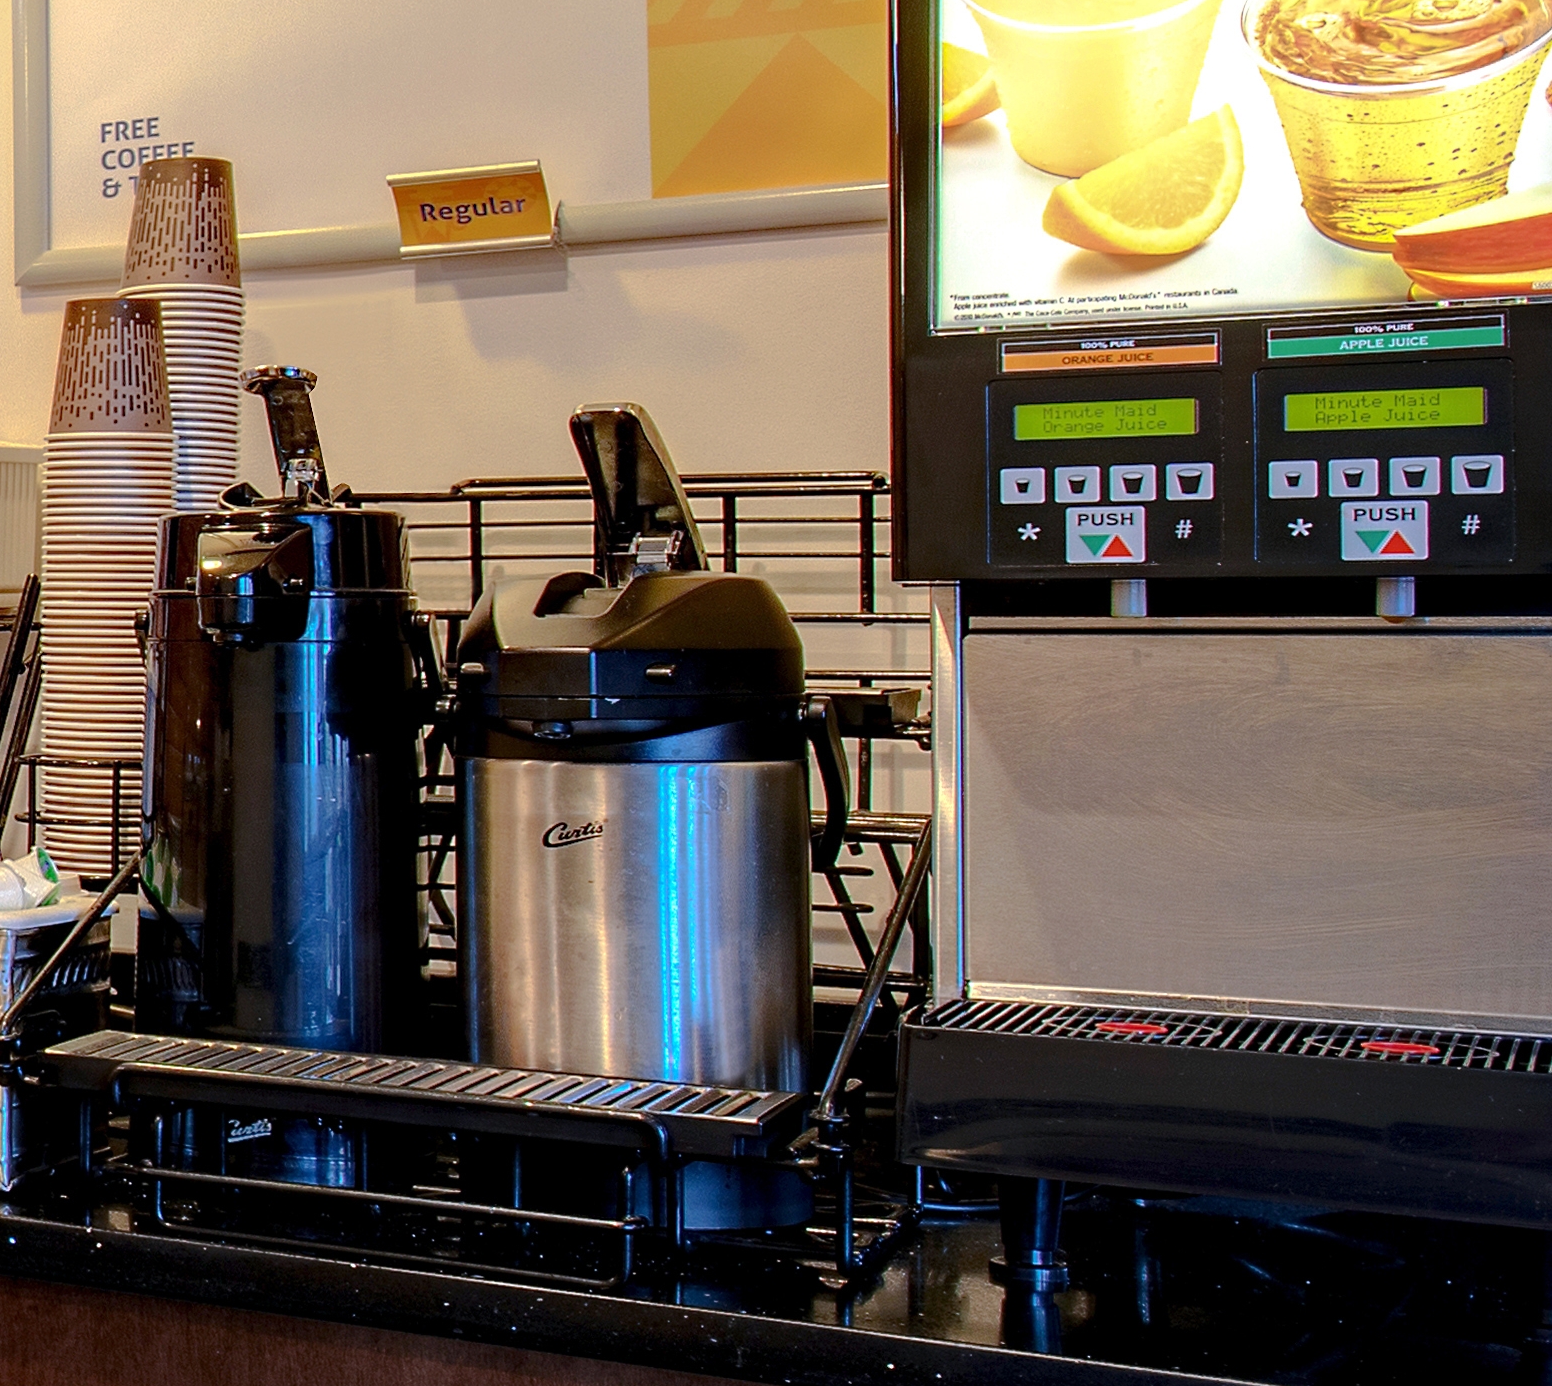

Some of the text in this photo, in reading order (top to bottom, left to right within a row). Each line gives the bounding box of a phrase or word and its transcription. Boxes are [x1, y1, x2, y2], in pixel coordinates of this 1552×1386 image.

[101, 117, 160, 143] FREE
[103, 178, 121, 198] &
[420, 197, 526, 224] Regular
[1354, 323, 1414, 334] 100% PURE
[1080, 339, 1136, 349] 100% PURE
[1339, 336, 1428, 350] APPLE JUICE
[1062, 352, 1154, 365] ORANGE JUICE
[1315, 393, 1441, 409] Minute Maid
[1043, 404, 1157, 420] Minute Maid
[1315, 409, 1440, 425] Apple Juice
[1043, 418, 1167, 433] Orange Juice
[1076, 513, 1134, 527] PUSH
[1354, 508, 1416, 522] PUSH
[542, 822, 603, 848] Curtis
